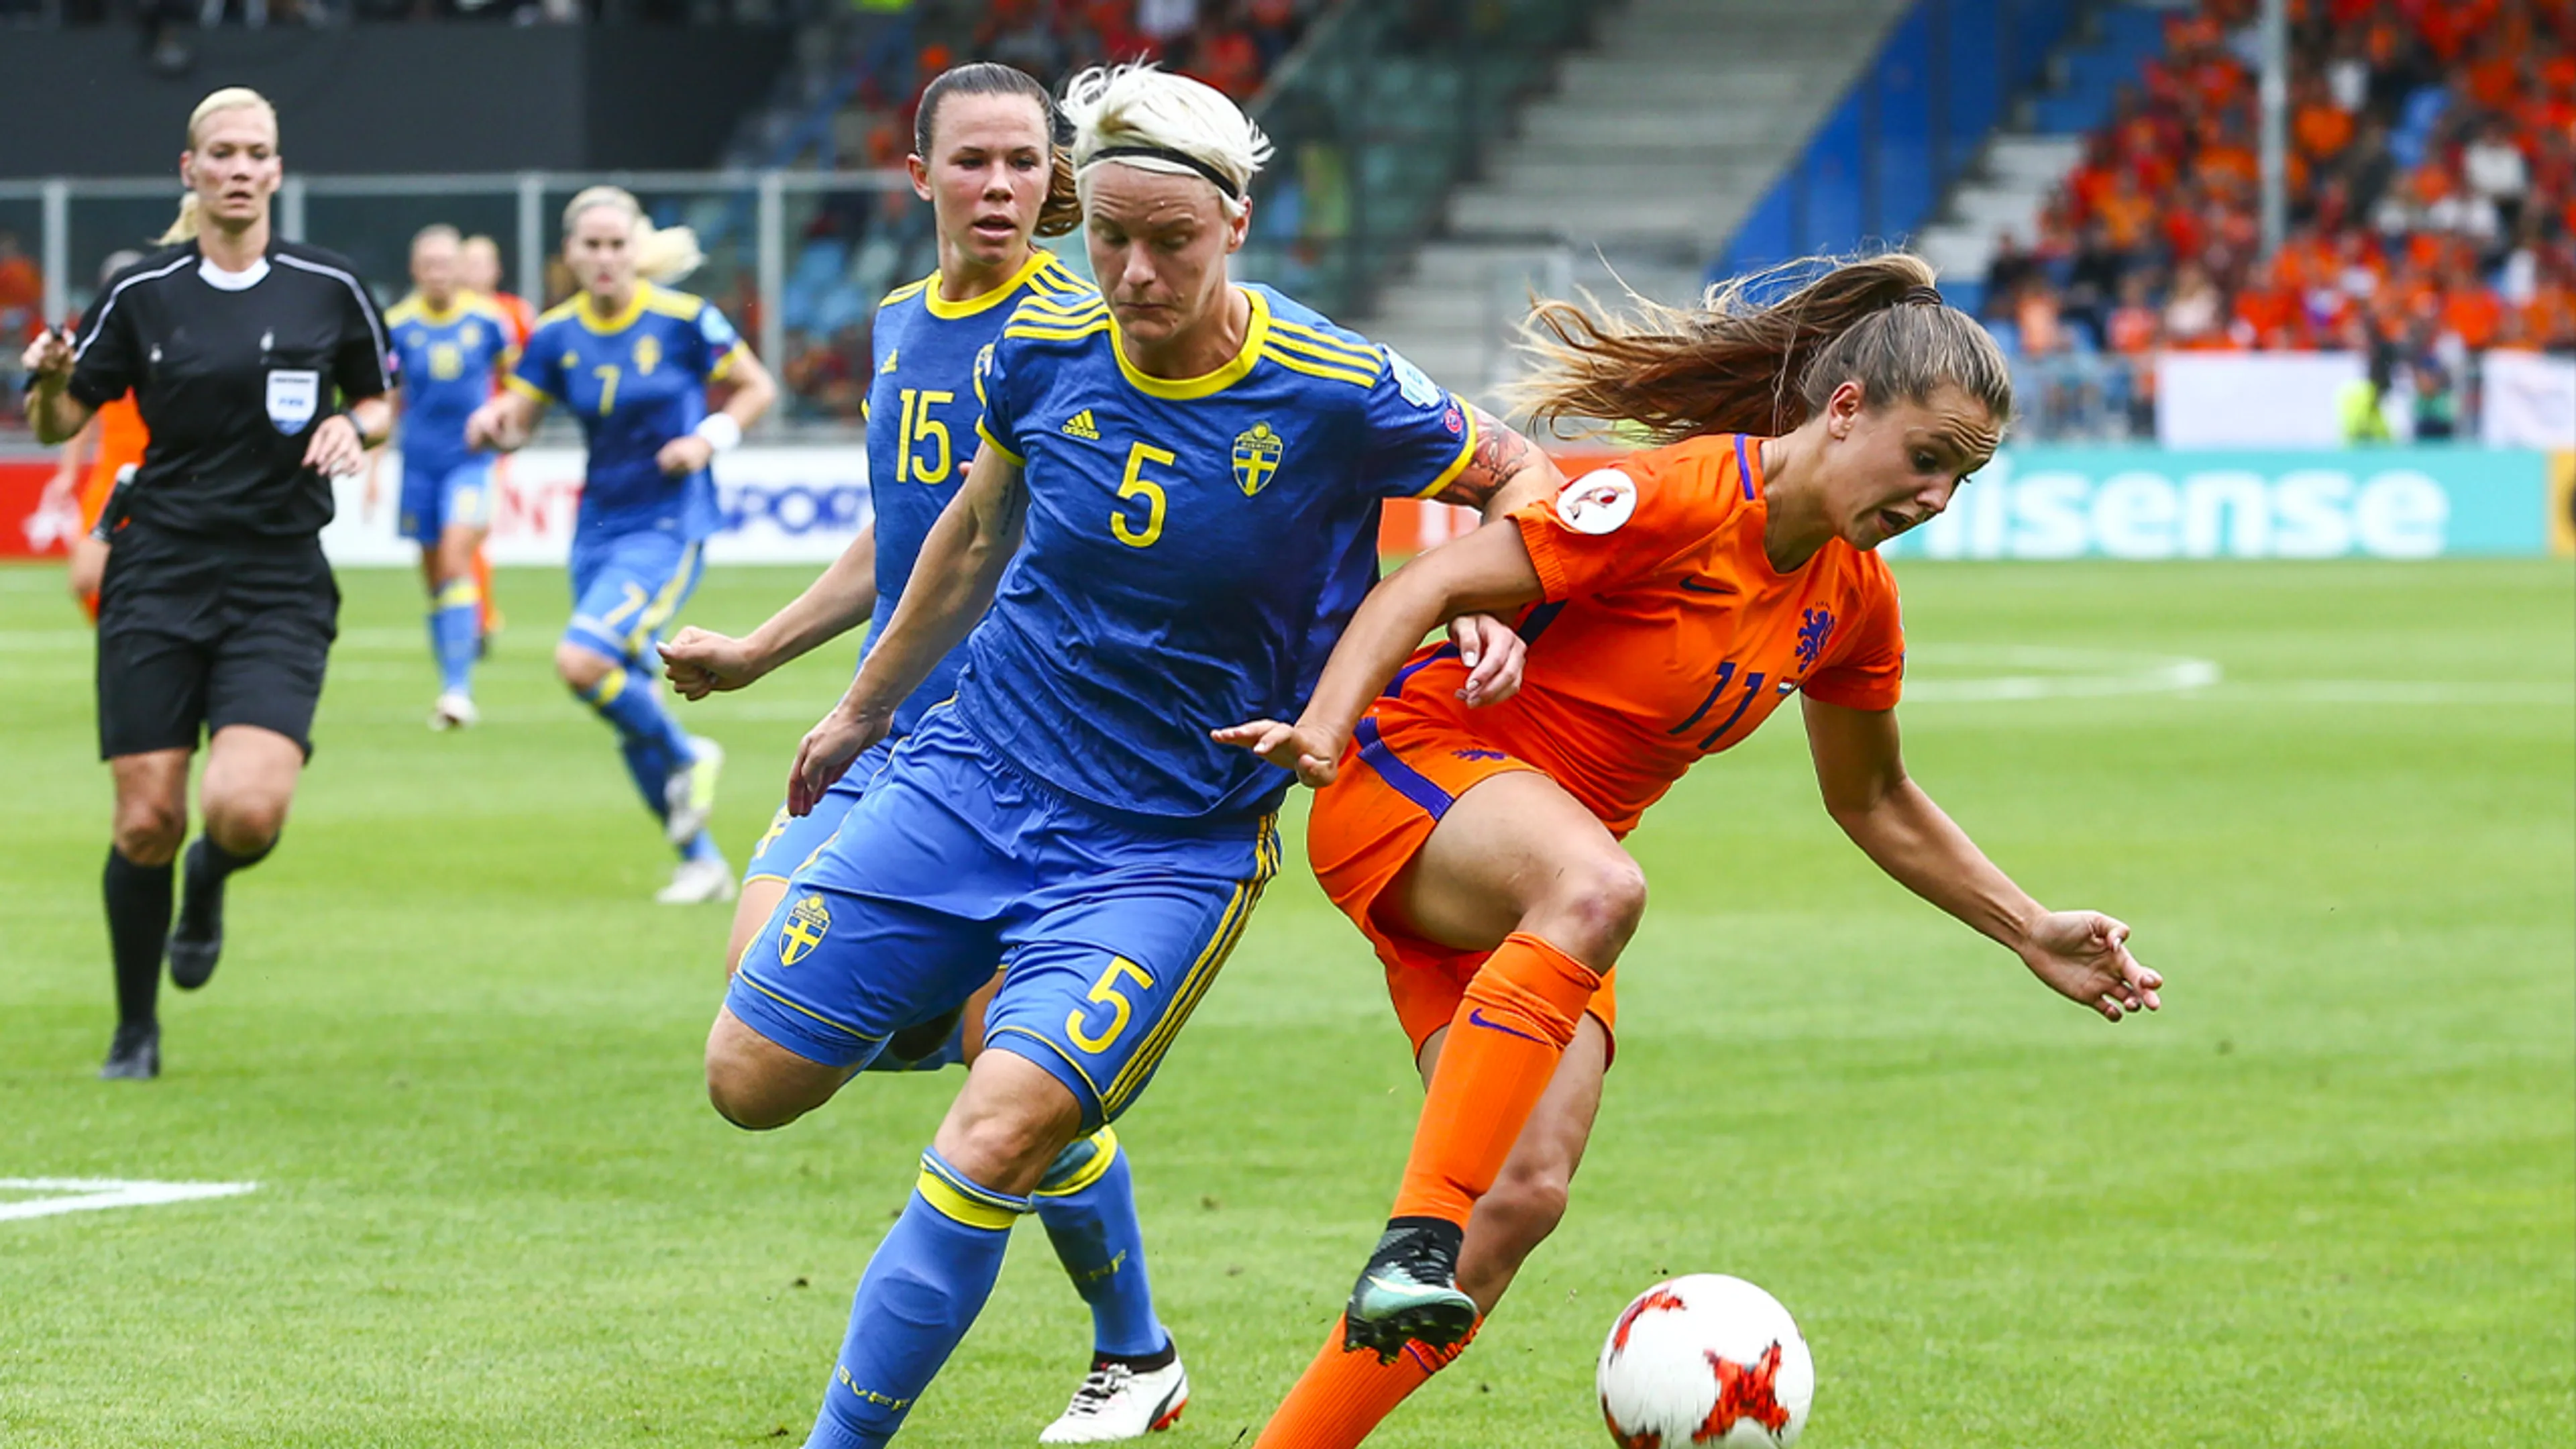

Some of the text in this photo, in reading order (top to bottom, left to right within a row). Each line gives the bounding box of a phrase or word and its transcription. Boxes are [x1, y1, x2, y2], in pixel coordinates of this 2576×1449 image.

[592, 364, 622, 417] 7
[896, 388, 955, 484] 15
[1111, 441, 1175, 547] 5
[1877, 455, 2451, 559] isense
[1667, 661, 1766, 751] 11
[1065, 955, 1155, 1054] 5
